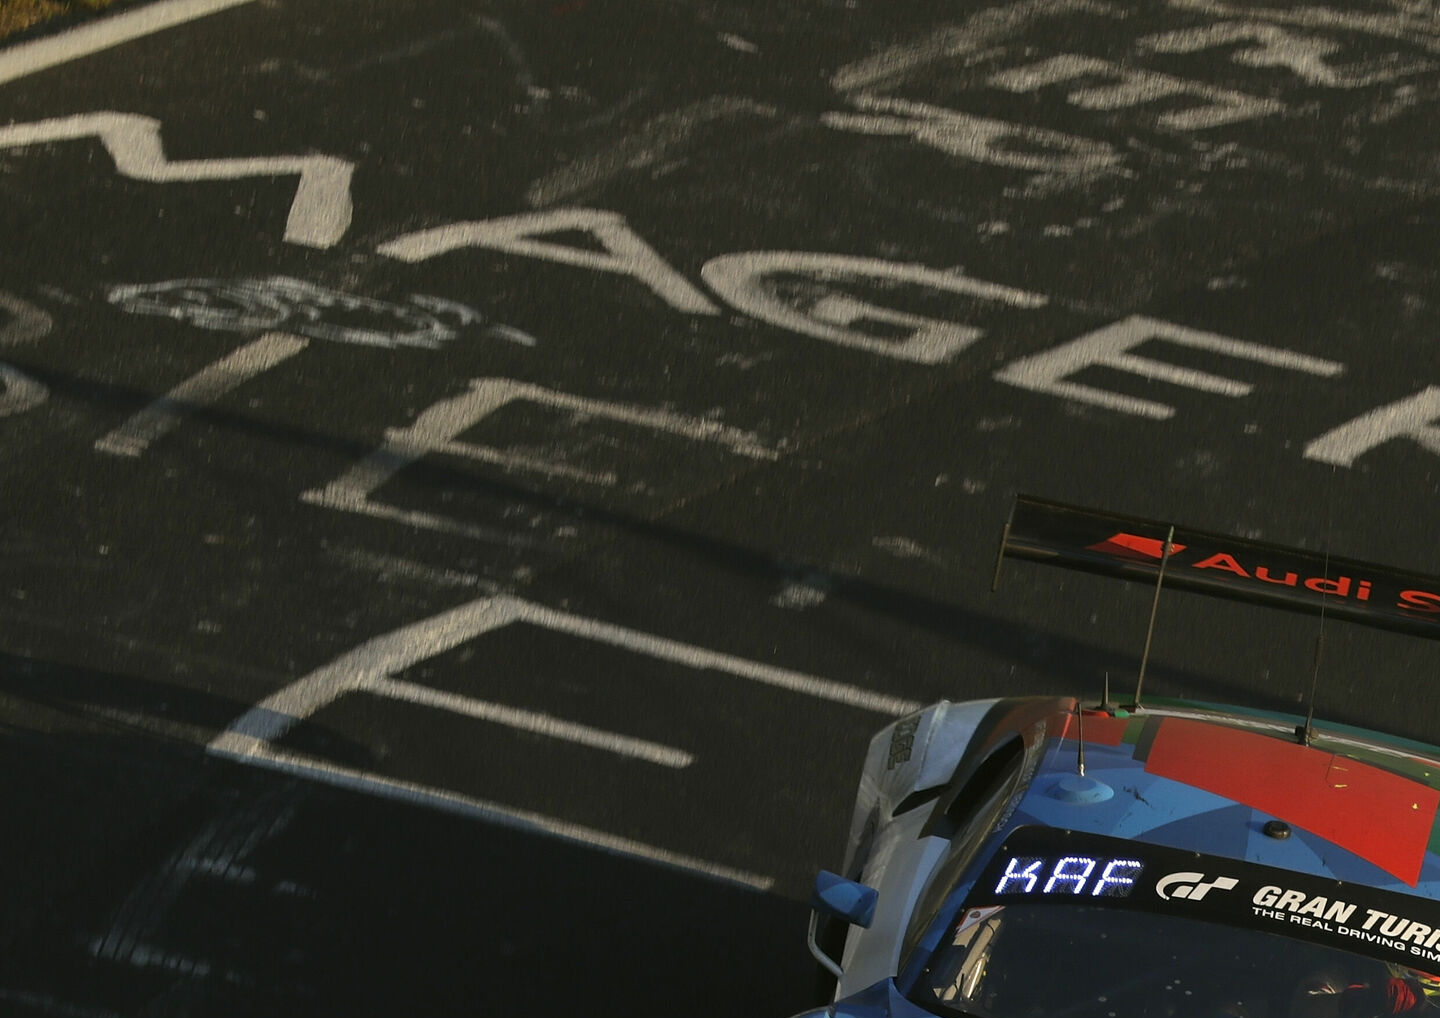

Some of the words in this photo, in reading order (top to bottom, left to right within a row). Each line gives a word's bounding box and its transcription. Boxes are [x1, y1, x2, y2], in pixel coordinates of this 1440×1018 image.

[1192, 553, 1372, 601] Audi
[994, 856, 1144, 897] KAF
[1251, 884, 1350, 925] GRAN
[1251, 907, 1285, 923] THE
[1290, 914, 1334, 933] REAL
[1338, 926, 1406, 952] DRIVING
